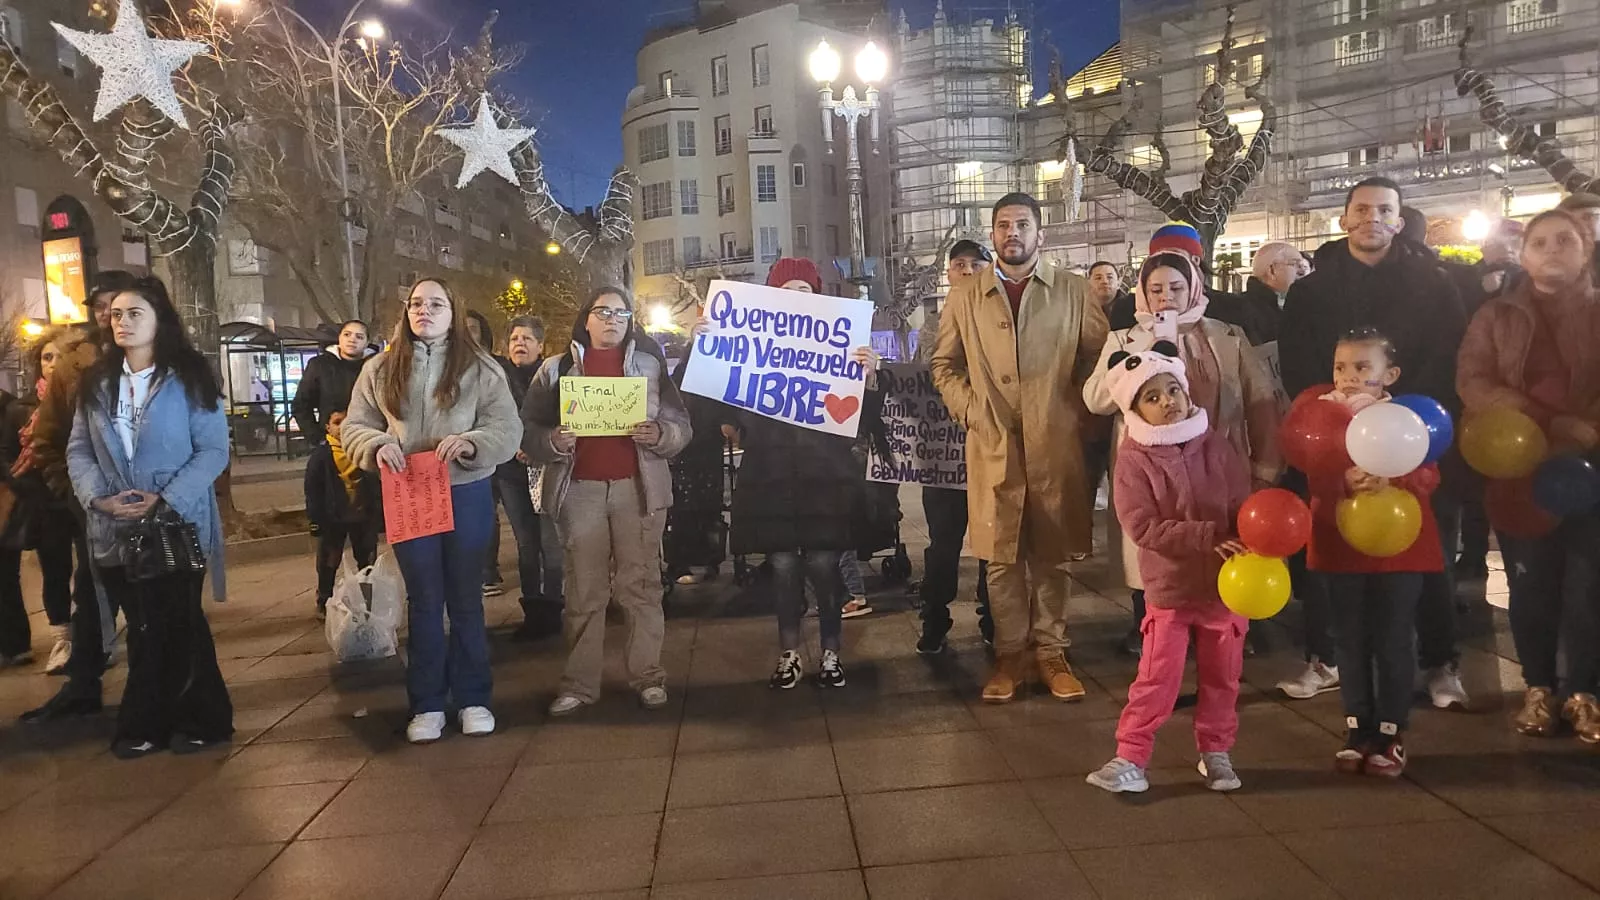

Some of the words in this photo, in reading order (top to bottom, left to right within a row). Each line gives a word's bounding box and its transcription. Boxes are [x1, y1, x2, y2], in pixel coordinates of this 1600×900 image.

[697, 334, 749, 363] UNA
[753, 337, 864, 381] Venezuela
[582, 384, 616, 398] Final
[723, 366, 831, 425] LIBRE
